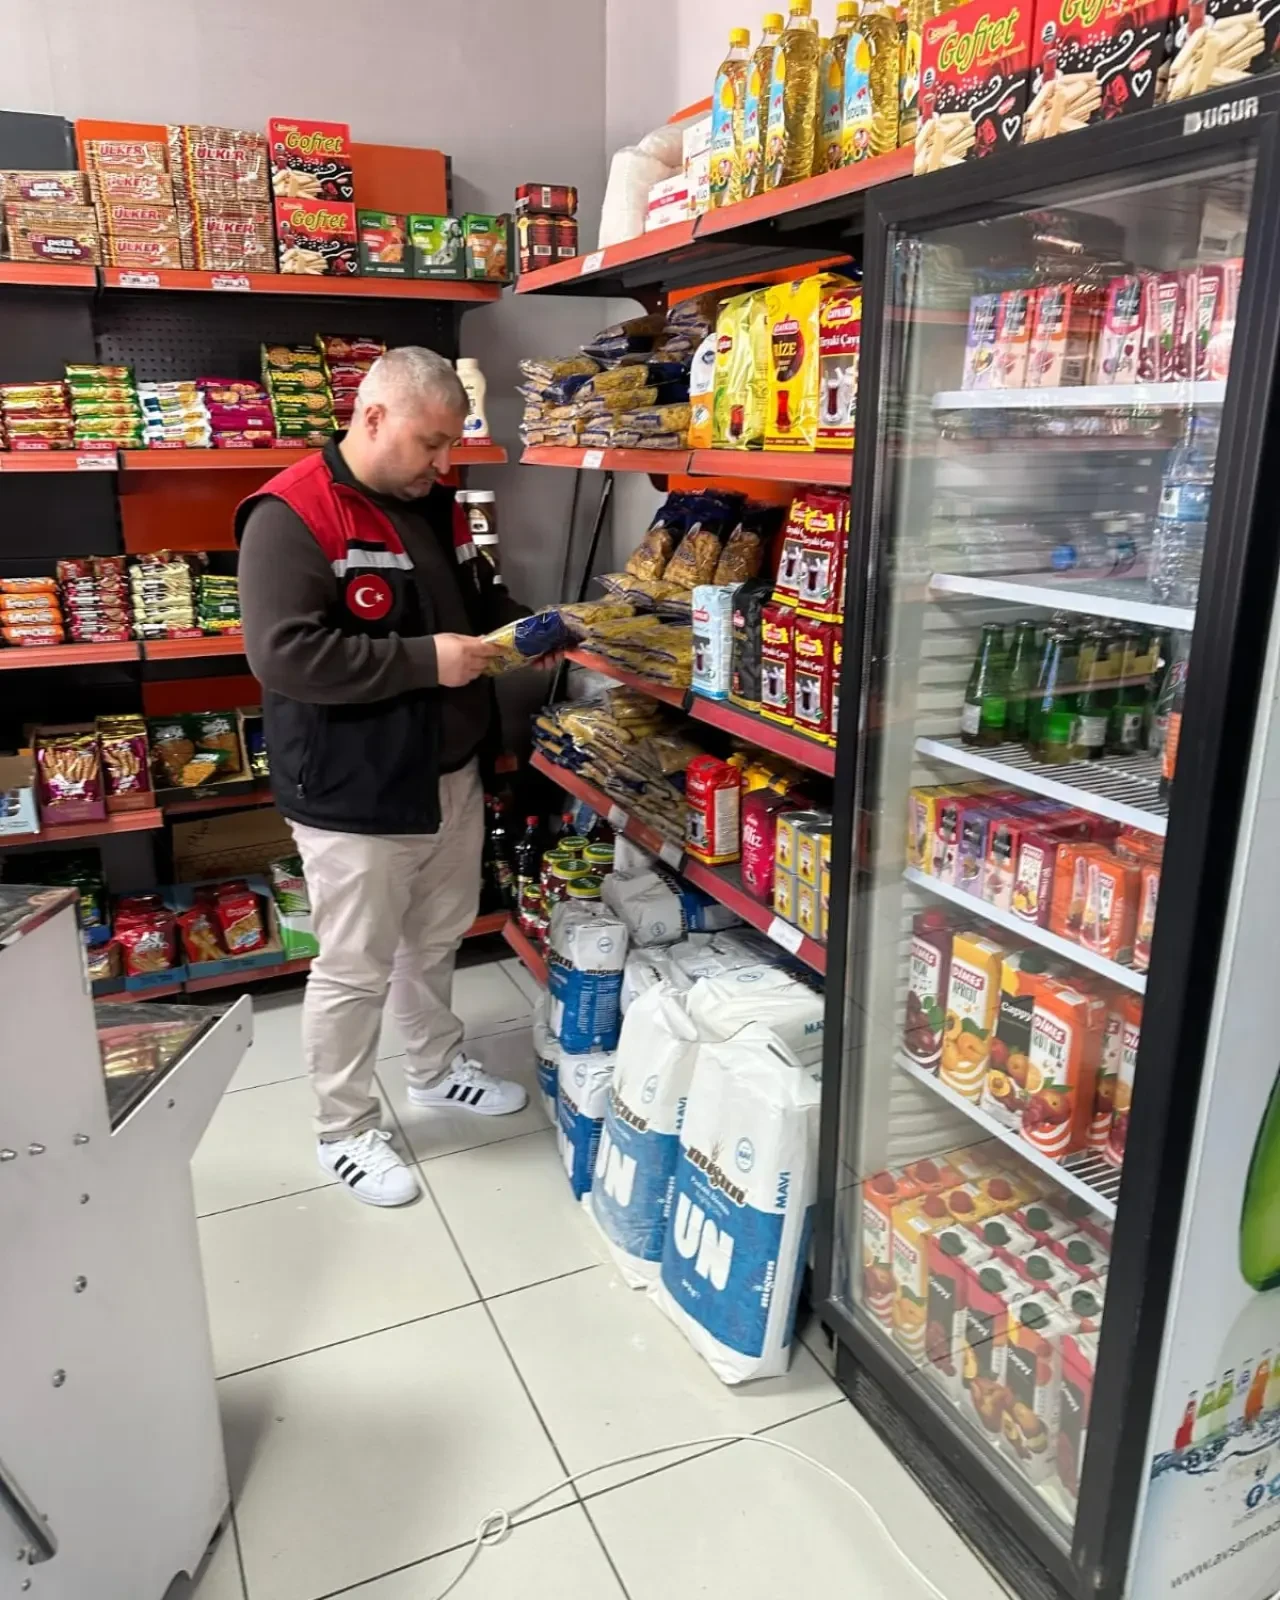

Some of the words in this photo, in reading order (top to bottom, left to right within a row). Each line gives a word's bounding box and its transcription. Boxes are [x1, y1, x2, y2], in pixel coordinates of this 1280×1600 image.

[938, 8, 1019, 73] Gofret
[286, 131, 342, 154] Gofret
[115, 207, 158, 219] ÜLKER
[291, 209, 347, 232] Gofret
[207, 219, 254, 233] ÜLKER
[118, 241, 160, 252] ÜLKER
[1001, 1001, 1034, 1022] Cappy
[774, 1171, 791, 1209] MAVI
[674, 1191, 735, 1291] UN
